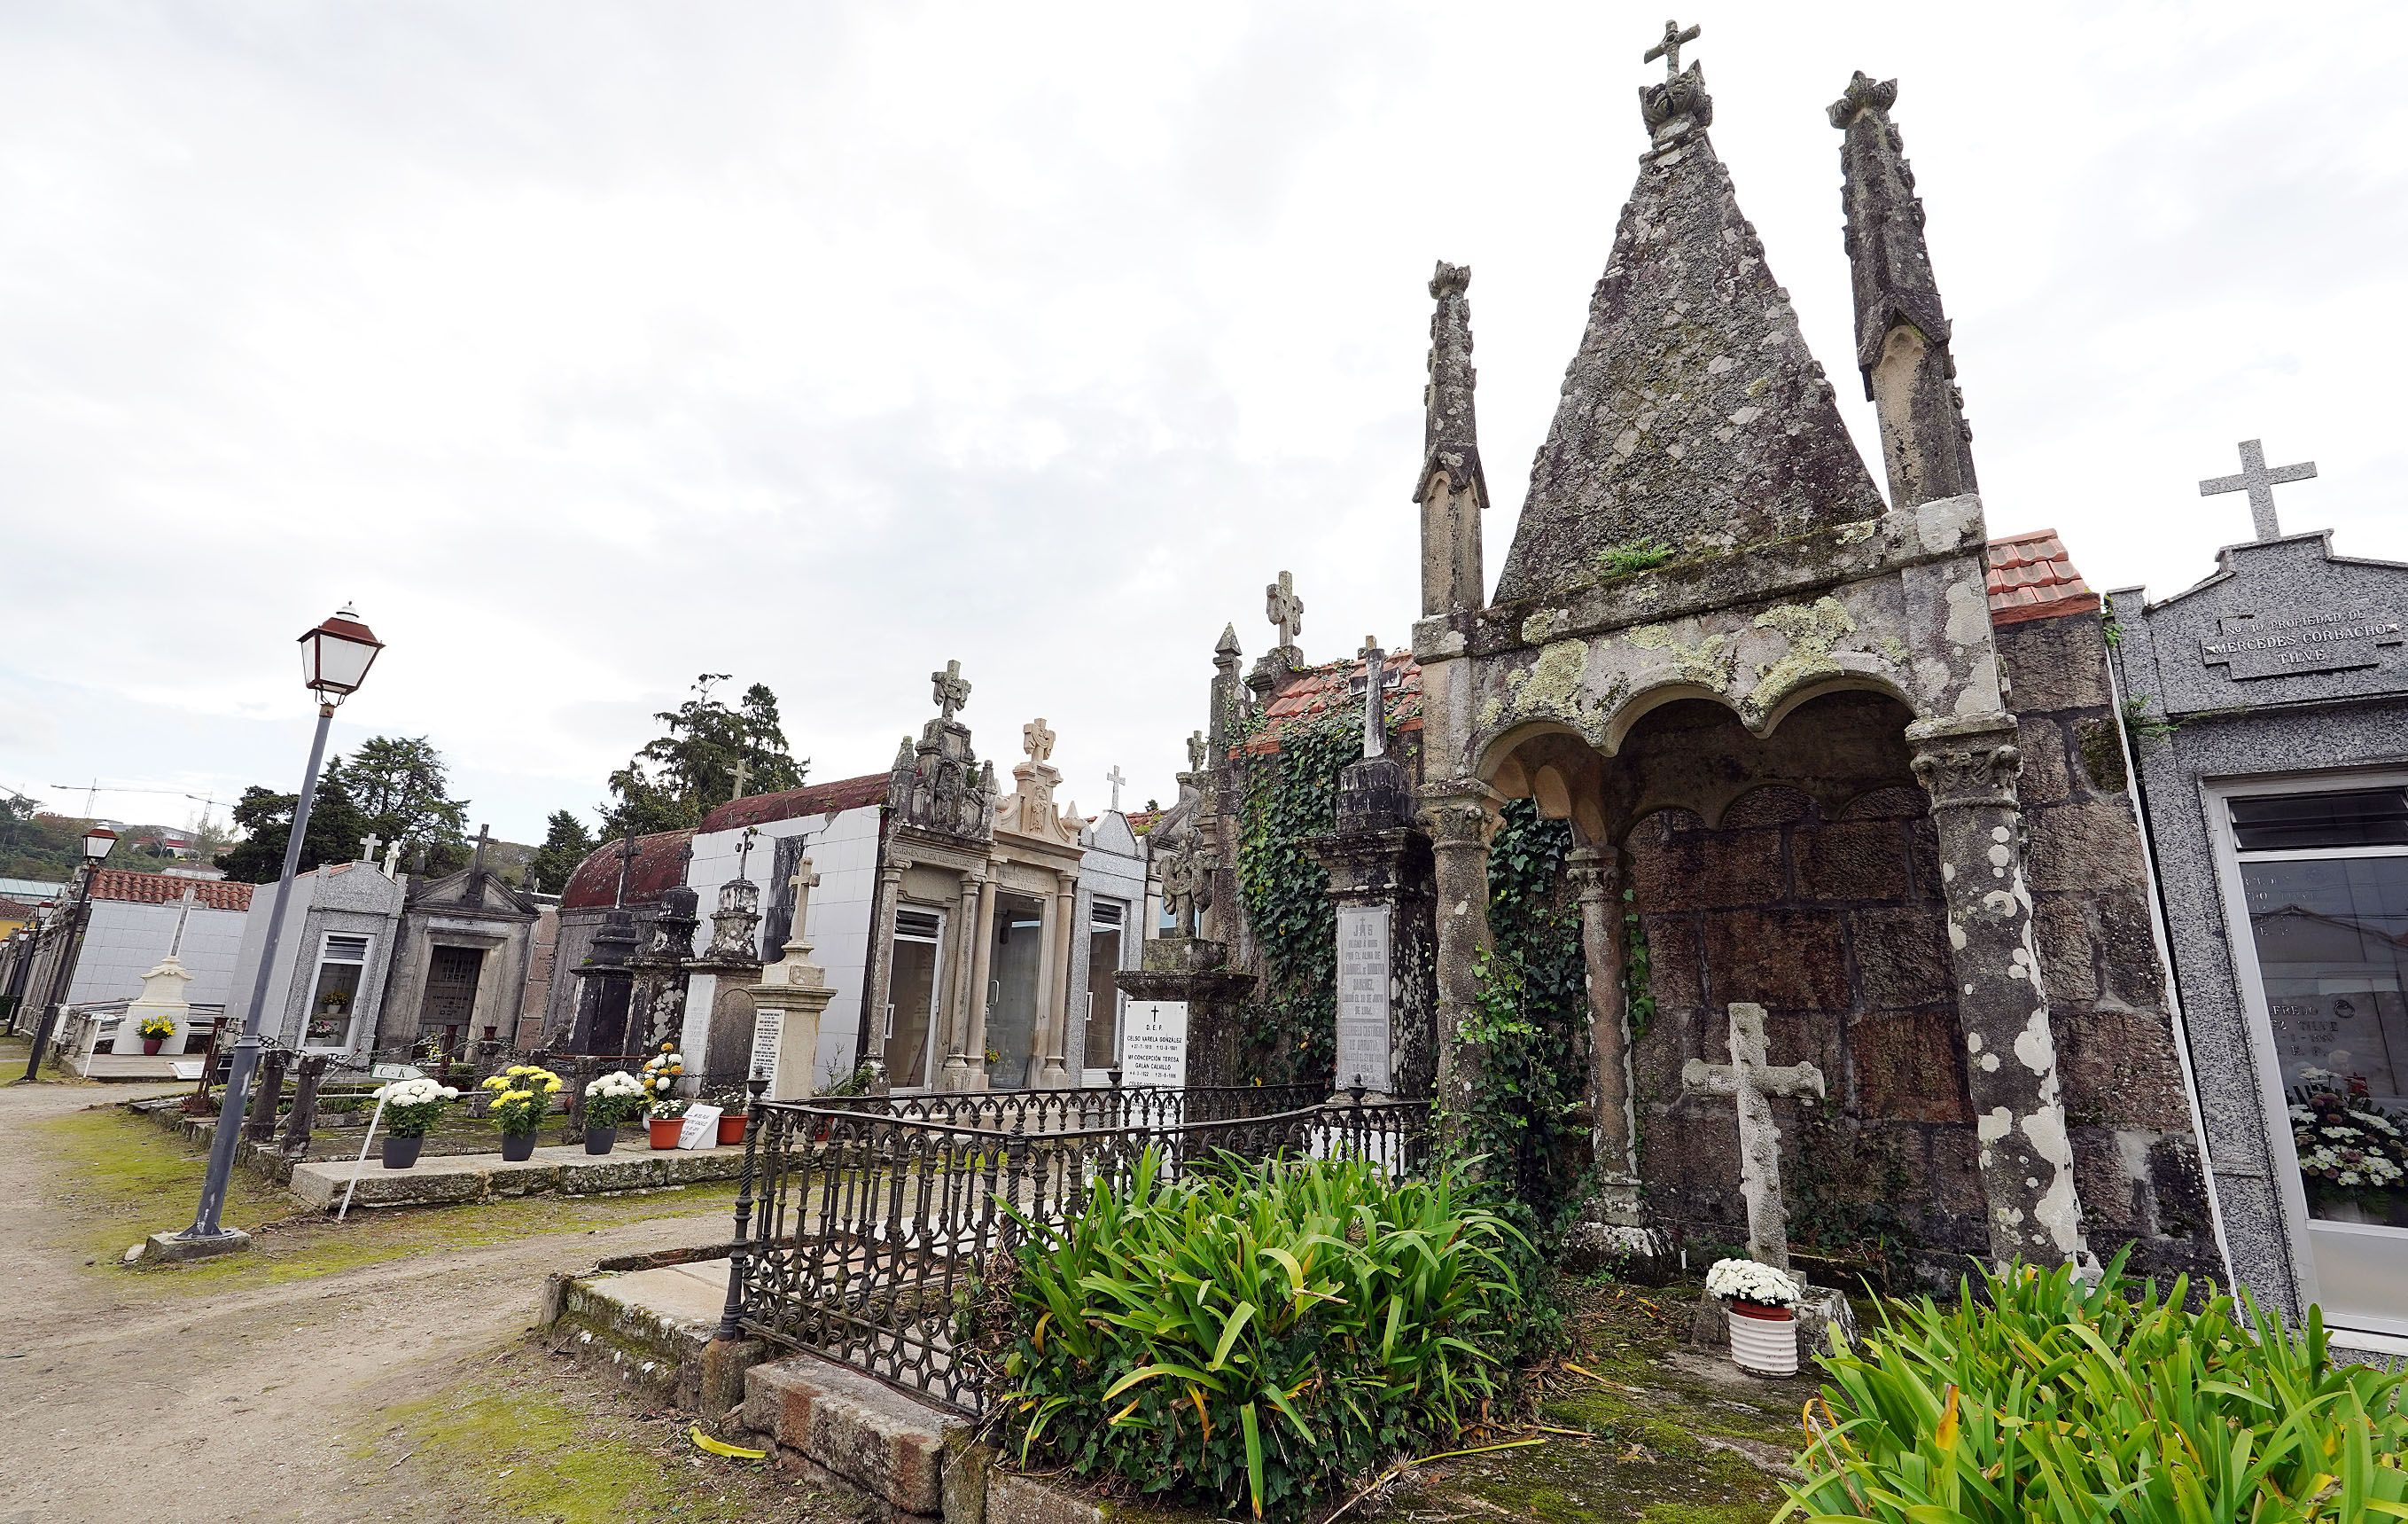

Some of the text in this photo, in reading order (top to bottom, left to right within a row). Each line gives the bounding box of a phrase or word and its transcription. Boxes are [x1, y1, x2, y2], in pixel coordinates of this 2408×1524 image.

[2251, 623, 2264, 633] 10
[2271, 614, 2342, 630] PROPIEDAD
[2349, 609, 2365, 621] DE
[2214, 623, 2387, 655] MERCEDES CORBACHO
[2278, 649, 2326, 666] TILVE
[894, 846, 919, 857] CARMEN
